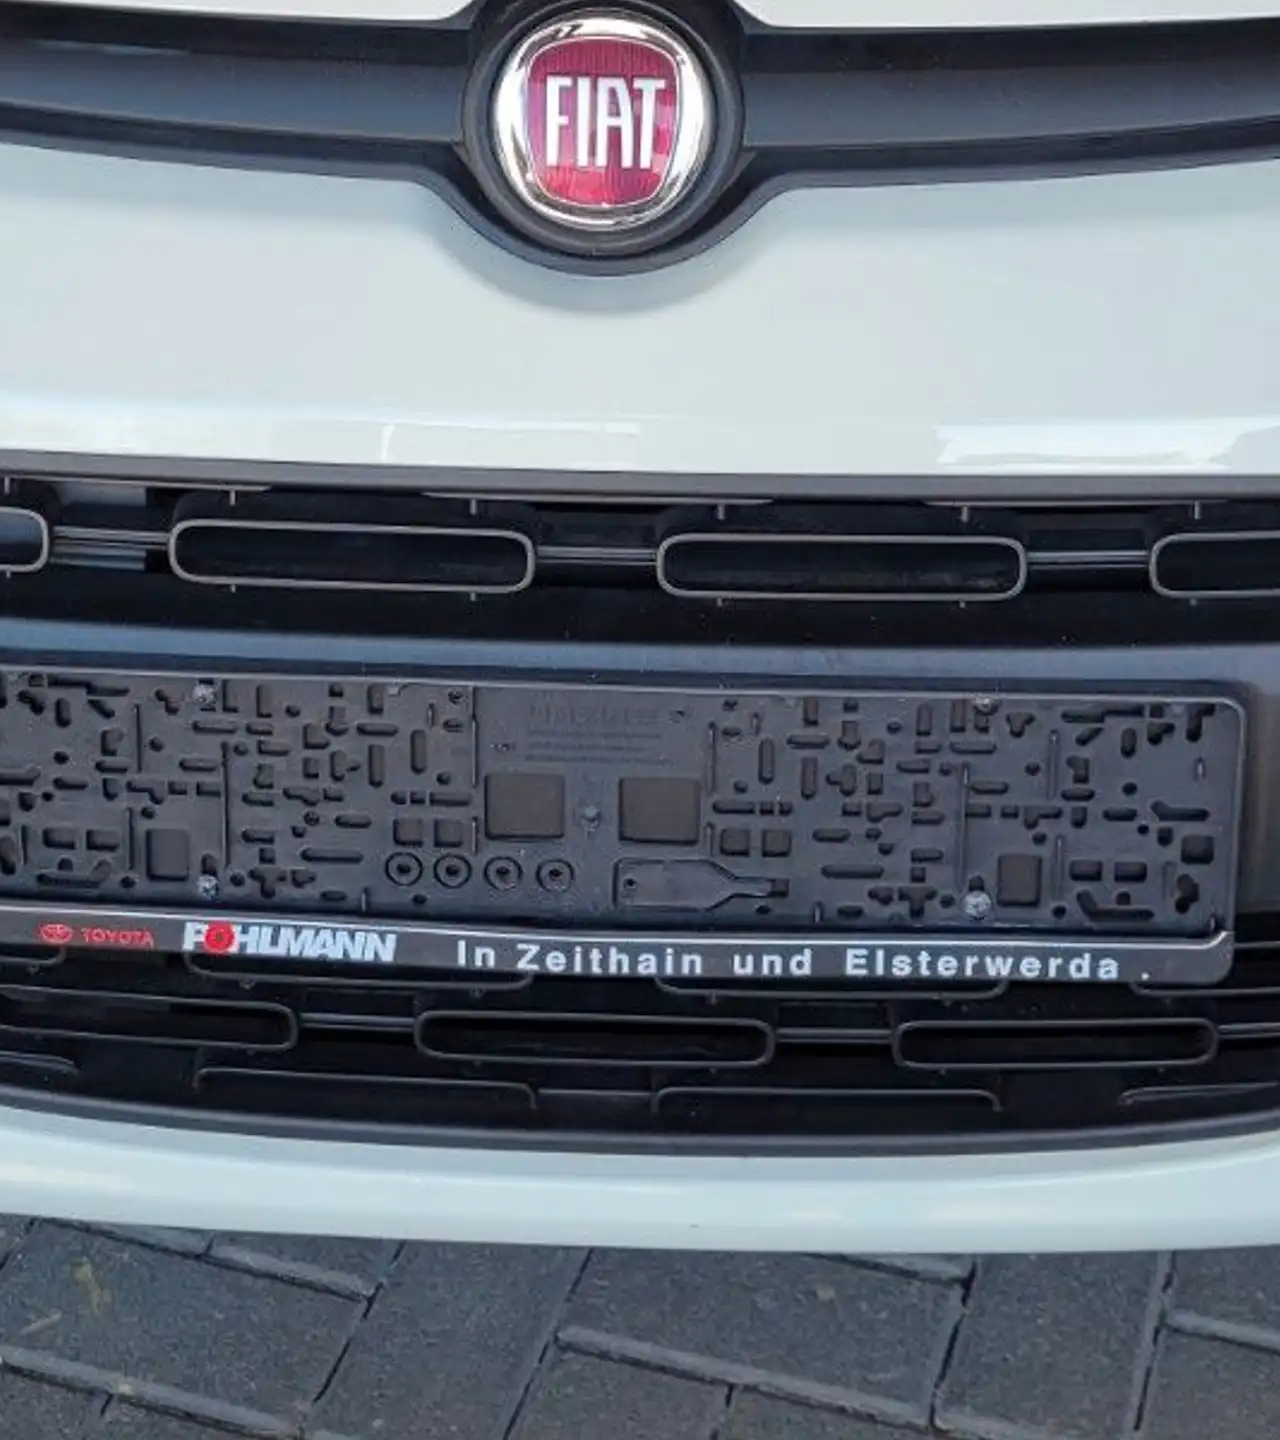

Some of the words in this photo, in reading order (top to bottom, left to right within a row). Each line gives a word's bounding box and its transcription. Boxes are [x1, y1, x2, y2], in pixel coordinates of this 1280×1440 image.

[545, 74, 667, 170] FIAT
[81, 927, 155, 947] TOYOTA
[457, 939, 497, 969] In
[517, 942, 703, 976] Zeithain
[733, 947, 814, 977] und
[845, 948, 1121, 981] Elsterwerda
